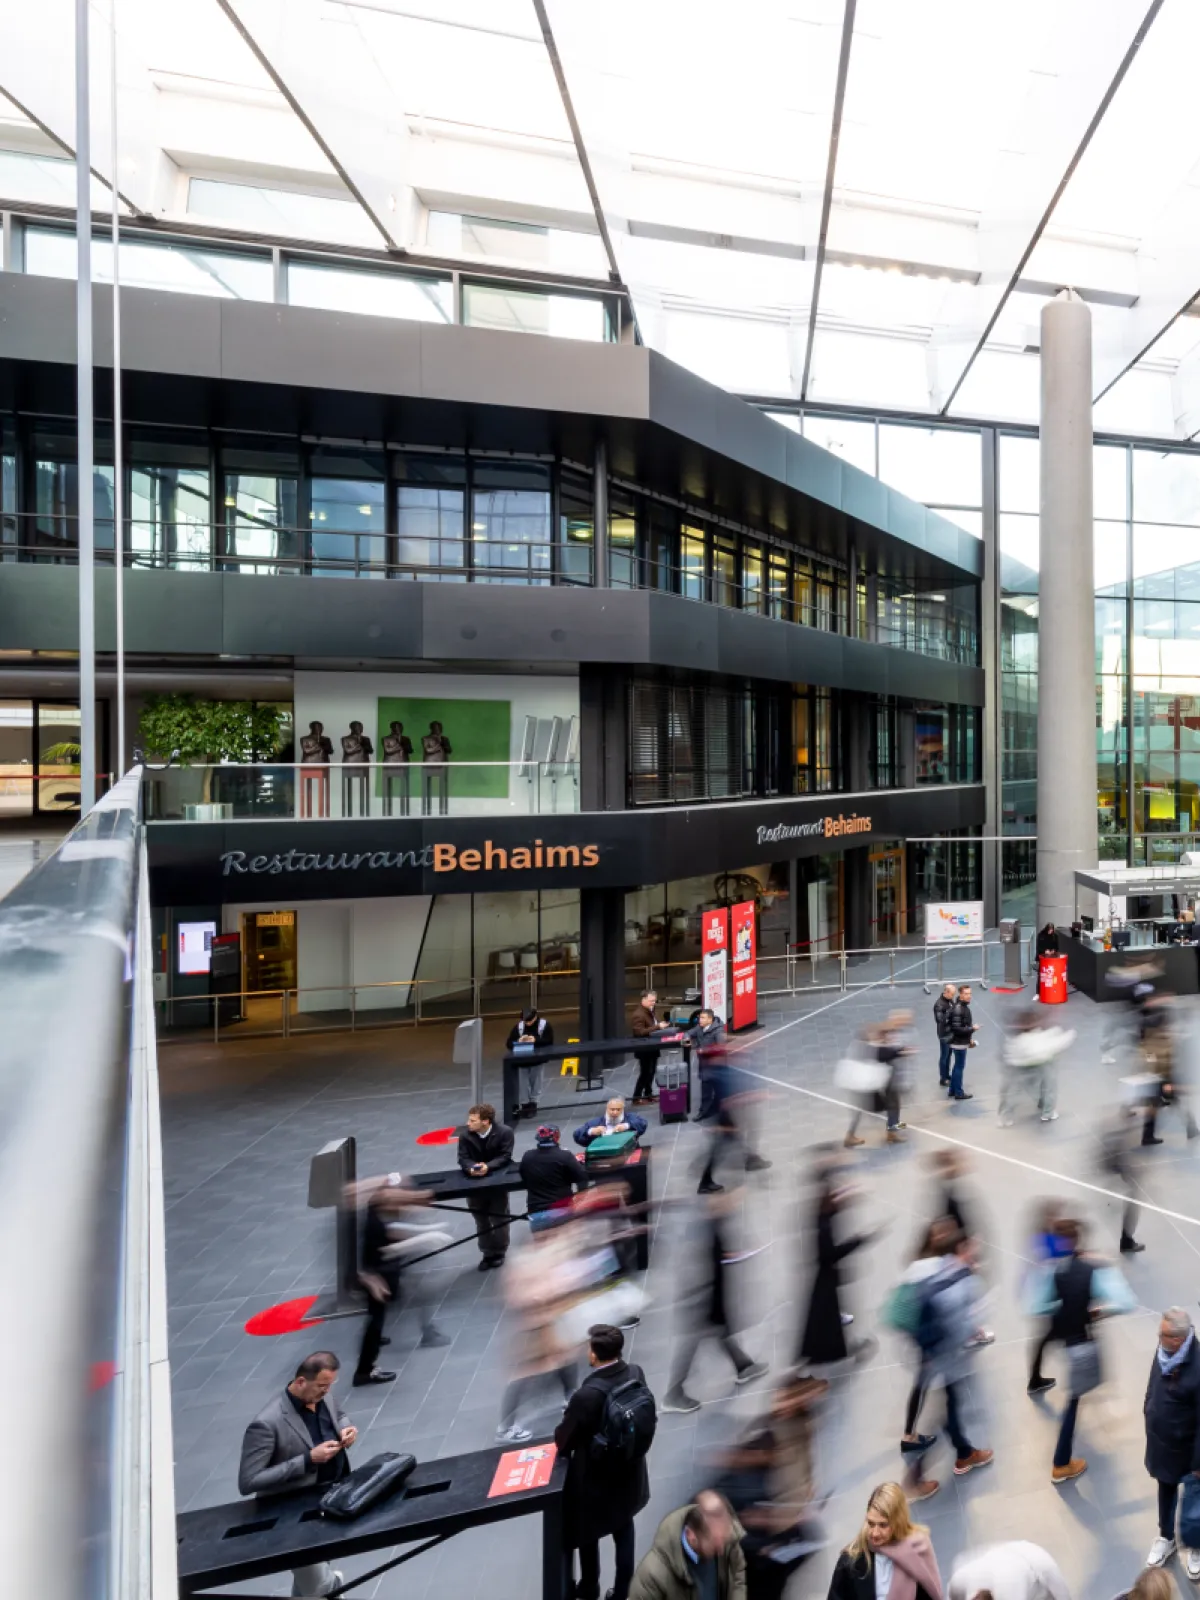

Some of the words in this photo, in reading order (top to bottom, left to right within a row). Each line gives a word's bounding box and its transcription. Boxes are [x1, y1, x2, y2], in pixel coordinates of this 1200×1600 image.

[757, 818, 824, 845] Restaurant
[824, 813, 871, 838] Behaims
[220, 845, 434, 876] Restaurant
[433, 840, 600, 872] Behaims
